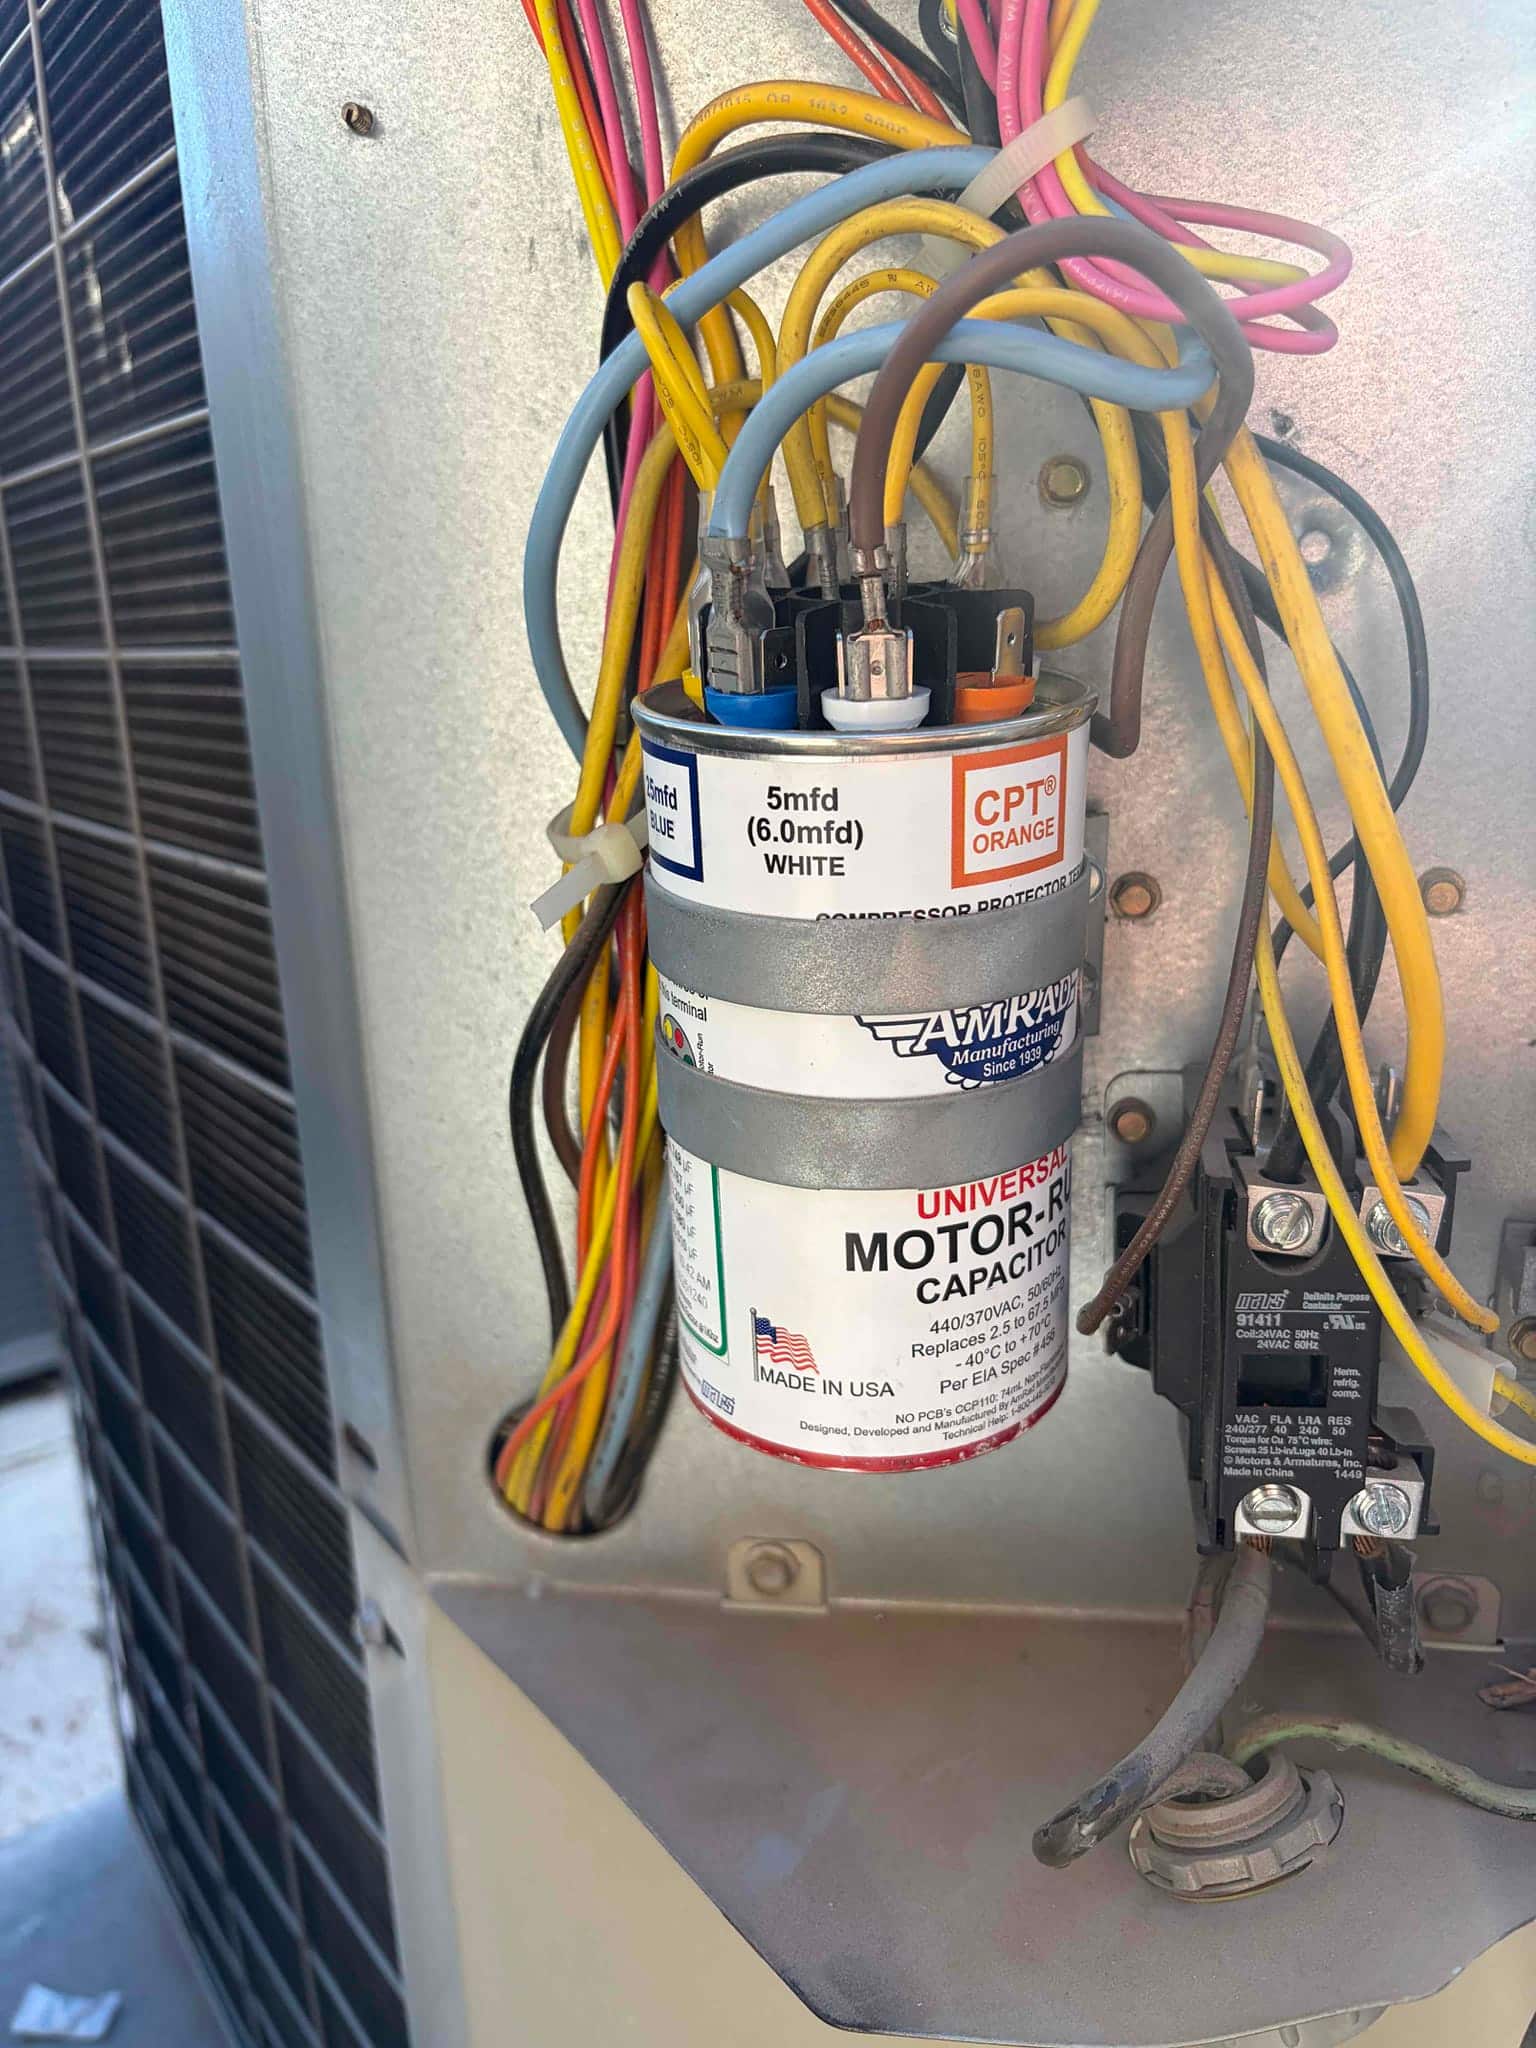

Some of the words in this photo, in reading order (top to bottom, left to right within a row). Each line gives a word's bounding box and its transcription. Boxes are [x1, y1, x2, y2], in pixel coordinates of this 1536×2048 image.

[766, 785, 839, 812] 5mfd
[650, 808, 676, 840] BLUE
[747, 815, 864, 851] (6.0mfd)
[972, 816, 1055, 854] ORANGE
[763, 853, 846, 877] WHITE
[670, 990, 708, 1022] terminal
[951, 1019, 1061, 1067] Manufacturing
[983, 1058, 1016, 1078] Since
[1019, 1045, 1042, 1067] 1939
[916, 1143, 1068, 1220] UNIVERSAL
[916, 1217, 1067, 1305] CAPACITOR
[1302, 1301, 1342, 1310] Contactor
[1336, 1292, 1370, 1303] Purpose
[929, 1295, 1024, 1334] 440/370VAC,
[1236, 1313, 1282, 1327] 91411
[911, 1332, 986, 1358] Replaces
[990, 1320, 1010, 1340] 2.5
[1013, 1315, 1025, 1330] to
[1027, 1295, 1049, 1321] 67.5
[1294, 1329, 1320, 1339] 50Hz
[1004, 1339, 1017, 1354] to
[1257, 1340, 1290, 1350] 24VAC
[1294, 1340, 1320, 1350] 60Hz
[759, 1365, 816, 1393] MADE
[822, 1379, 843, 1397] IN
[849, 1381, 896, 1398] USA
[940, 1377, 968, 1394] Per
[972, 1366, 998, 1386] EIA
[1000, 1351, 1031, 1375] Spec
[1331, 1390, 1361, 1400] comp.
[800, 1420, 851, 1436] Designed,
[854, 1427, 910, 1437] Developed
[912, 1423, 932, 1434] and
[934, 1403, 997, 1431] Manufactured
[895, 1413, 915, 1424] NO
[918, 1407, 952, 1422] PCB's
[1235, 1414, 1259, 1423] VAC
[1270, 1415, 1292, 1424] FLA
[1298, 1415, 1322, 1425] LRA
[1327, 1416, 1352, 1425] RES
[943, 1420, 986, 1440] Technical
[1224, 1434, 1256, 1444] Torque
[1257, 1435, 1270, 1444] for
[1271, 1435, 1284, 1444] Cu
[1225, 1424, 1267, 1434] 240/277
[1274, 1425, 1287, 1434] 40
[1299, 1425, 1319, 1435] 240
[1331, 1426, 1346, 1436] 50
[1224, 1445, 1257, 1455] Screws
[1258, 1446, 1268, 1454] 25
[1317, 1447, 1328, 1456] 40
[1234, 1456, 1271, 1466] Motors
[1272, 1457, 1281, 1466] &
[1282, 1457, 1341, 1468] Armatures,
[1343, 1458, 1363, 1468] Inc.
[1223, 1467, 1251, 1477] Made
[1252, 1467, 1263, 1477] in
[1264, 1467, 1294, 1478] China
[1334, 1469, 1363, 1480] 1449
